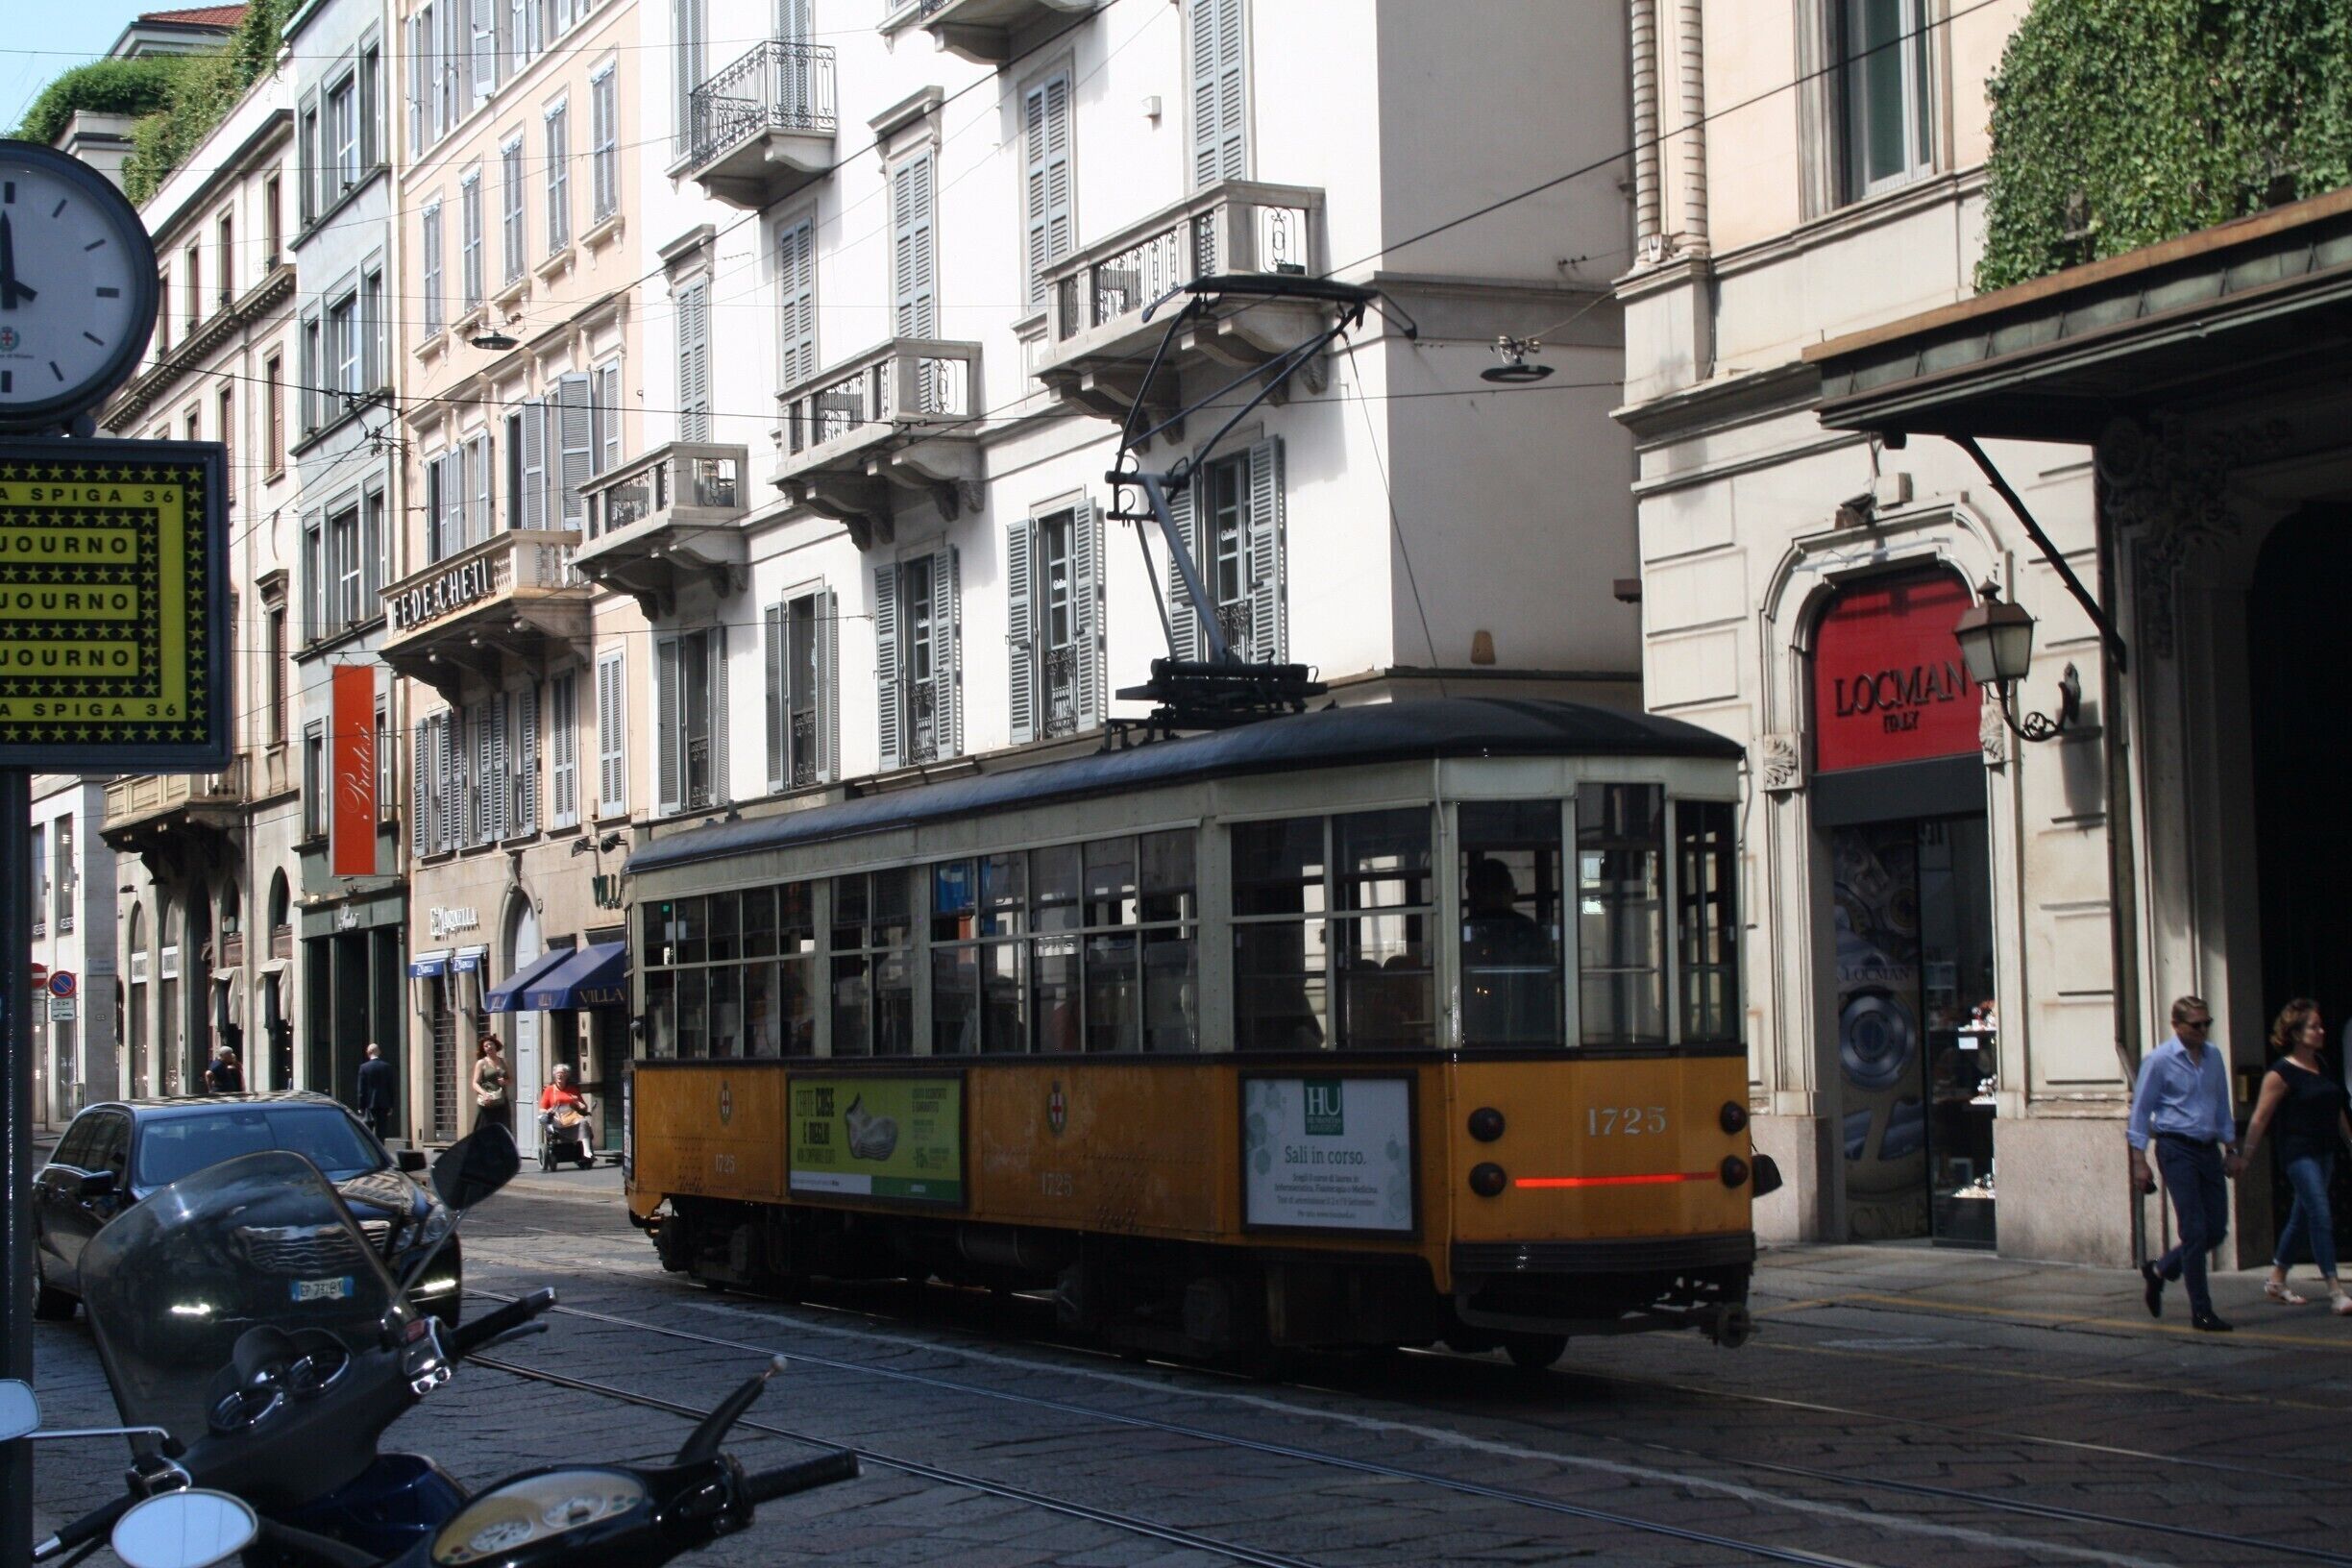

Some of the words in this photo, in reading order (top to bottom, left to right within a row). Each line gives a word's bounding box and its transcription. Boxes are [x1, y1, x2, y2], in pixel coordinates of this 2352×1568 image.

[31, 488, 123, 502] SPIGA
[144, 490, 175, 503] 36
[391, 582, 433, 630] FEDE
[1833, 660, 1968, 718] LOCMAN
[33, 703, 125, 716] SPIGA
[146, 703, 177, 717] 36
[1306, 1086, 1341, 1116] HU
[1586, 1106, 1667, 1137] 1725
[1285, 1144, 1309, 1164] Sali
[1311, 1145, 1325, 1164] in
[1041, 1171, 1073, 1198] 1725
